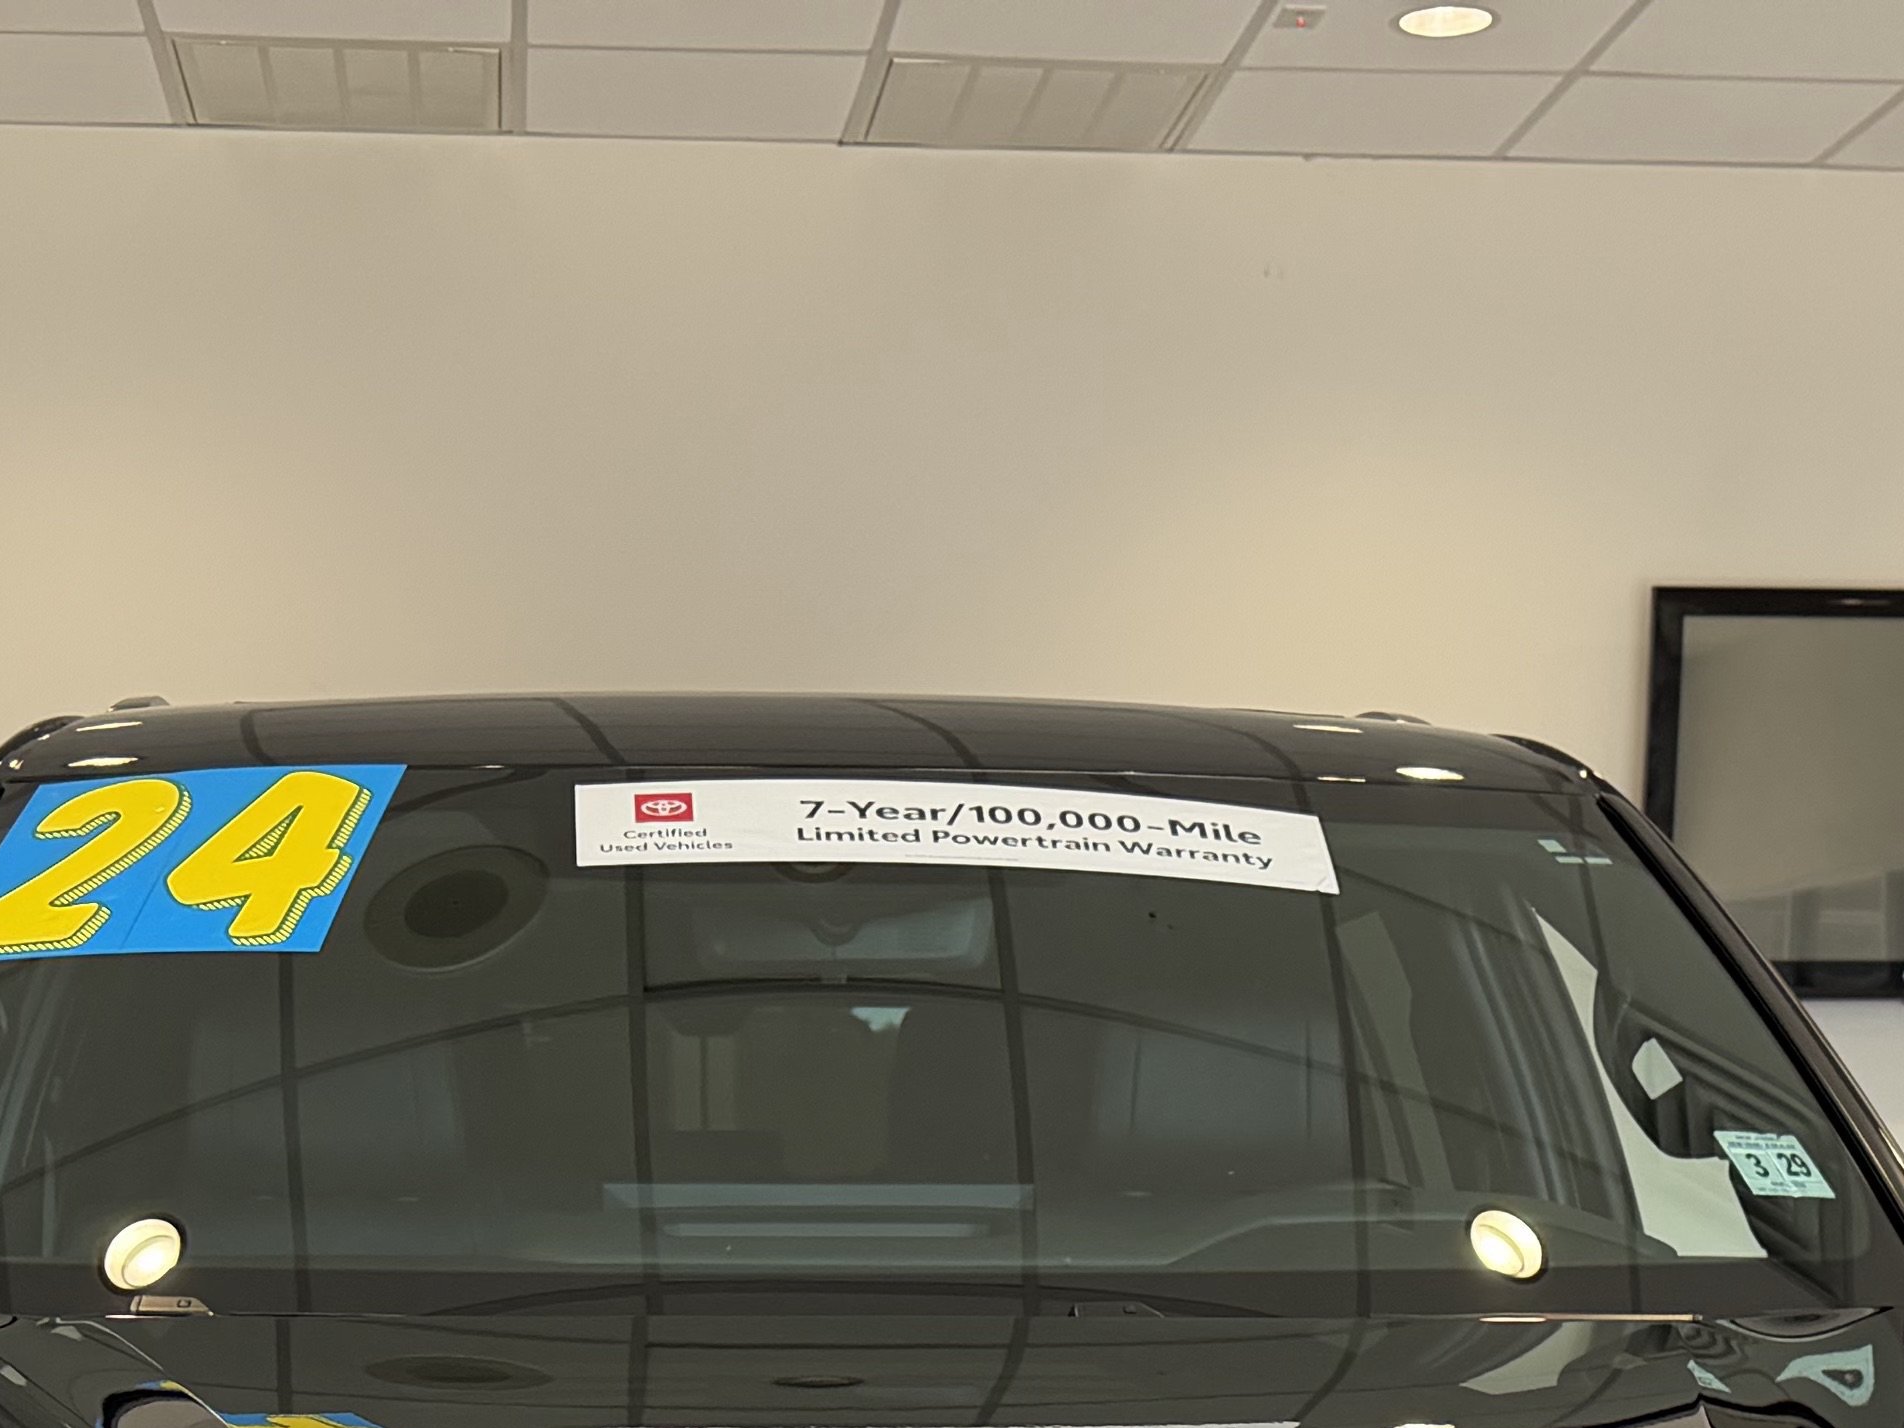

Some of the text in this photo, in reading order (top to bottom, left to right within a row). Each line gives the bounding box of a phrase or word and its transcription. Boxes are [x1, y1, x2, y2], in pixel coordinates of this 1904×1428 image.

[622, 827, 708, 840] Certified
[798, 798, 1264, 847] 7-Year/100,000-Mile
[599, 840, 734, 854] Used Vehicles
[796, 826, 1274, 871] Limited Powertrain Warranty
[1745, 1152, 1812, 1178] 3 29
